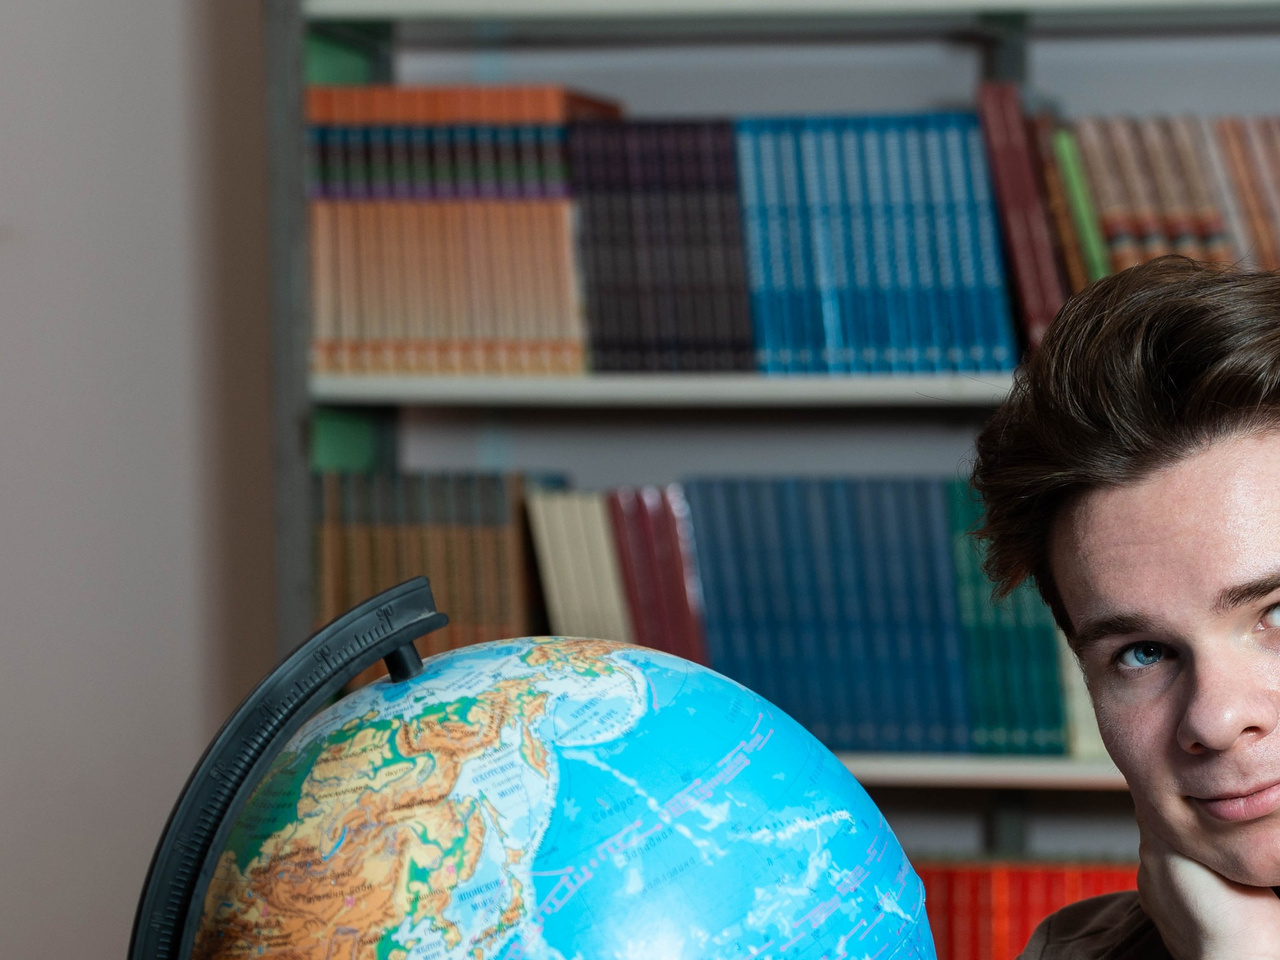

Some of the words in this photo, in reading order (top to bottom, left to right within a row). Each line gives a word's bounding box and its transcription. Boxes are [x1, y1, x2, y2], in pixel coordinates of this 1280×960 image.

[471, 760, 517, 786] ОХОТСКОЕ
[497, 783, 523, 800] МОРЕ
[458, 879, 501, 902] ЯПОНСКОЕ
[470, 896, 496, 913] МОРЕ
